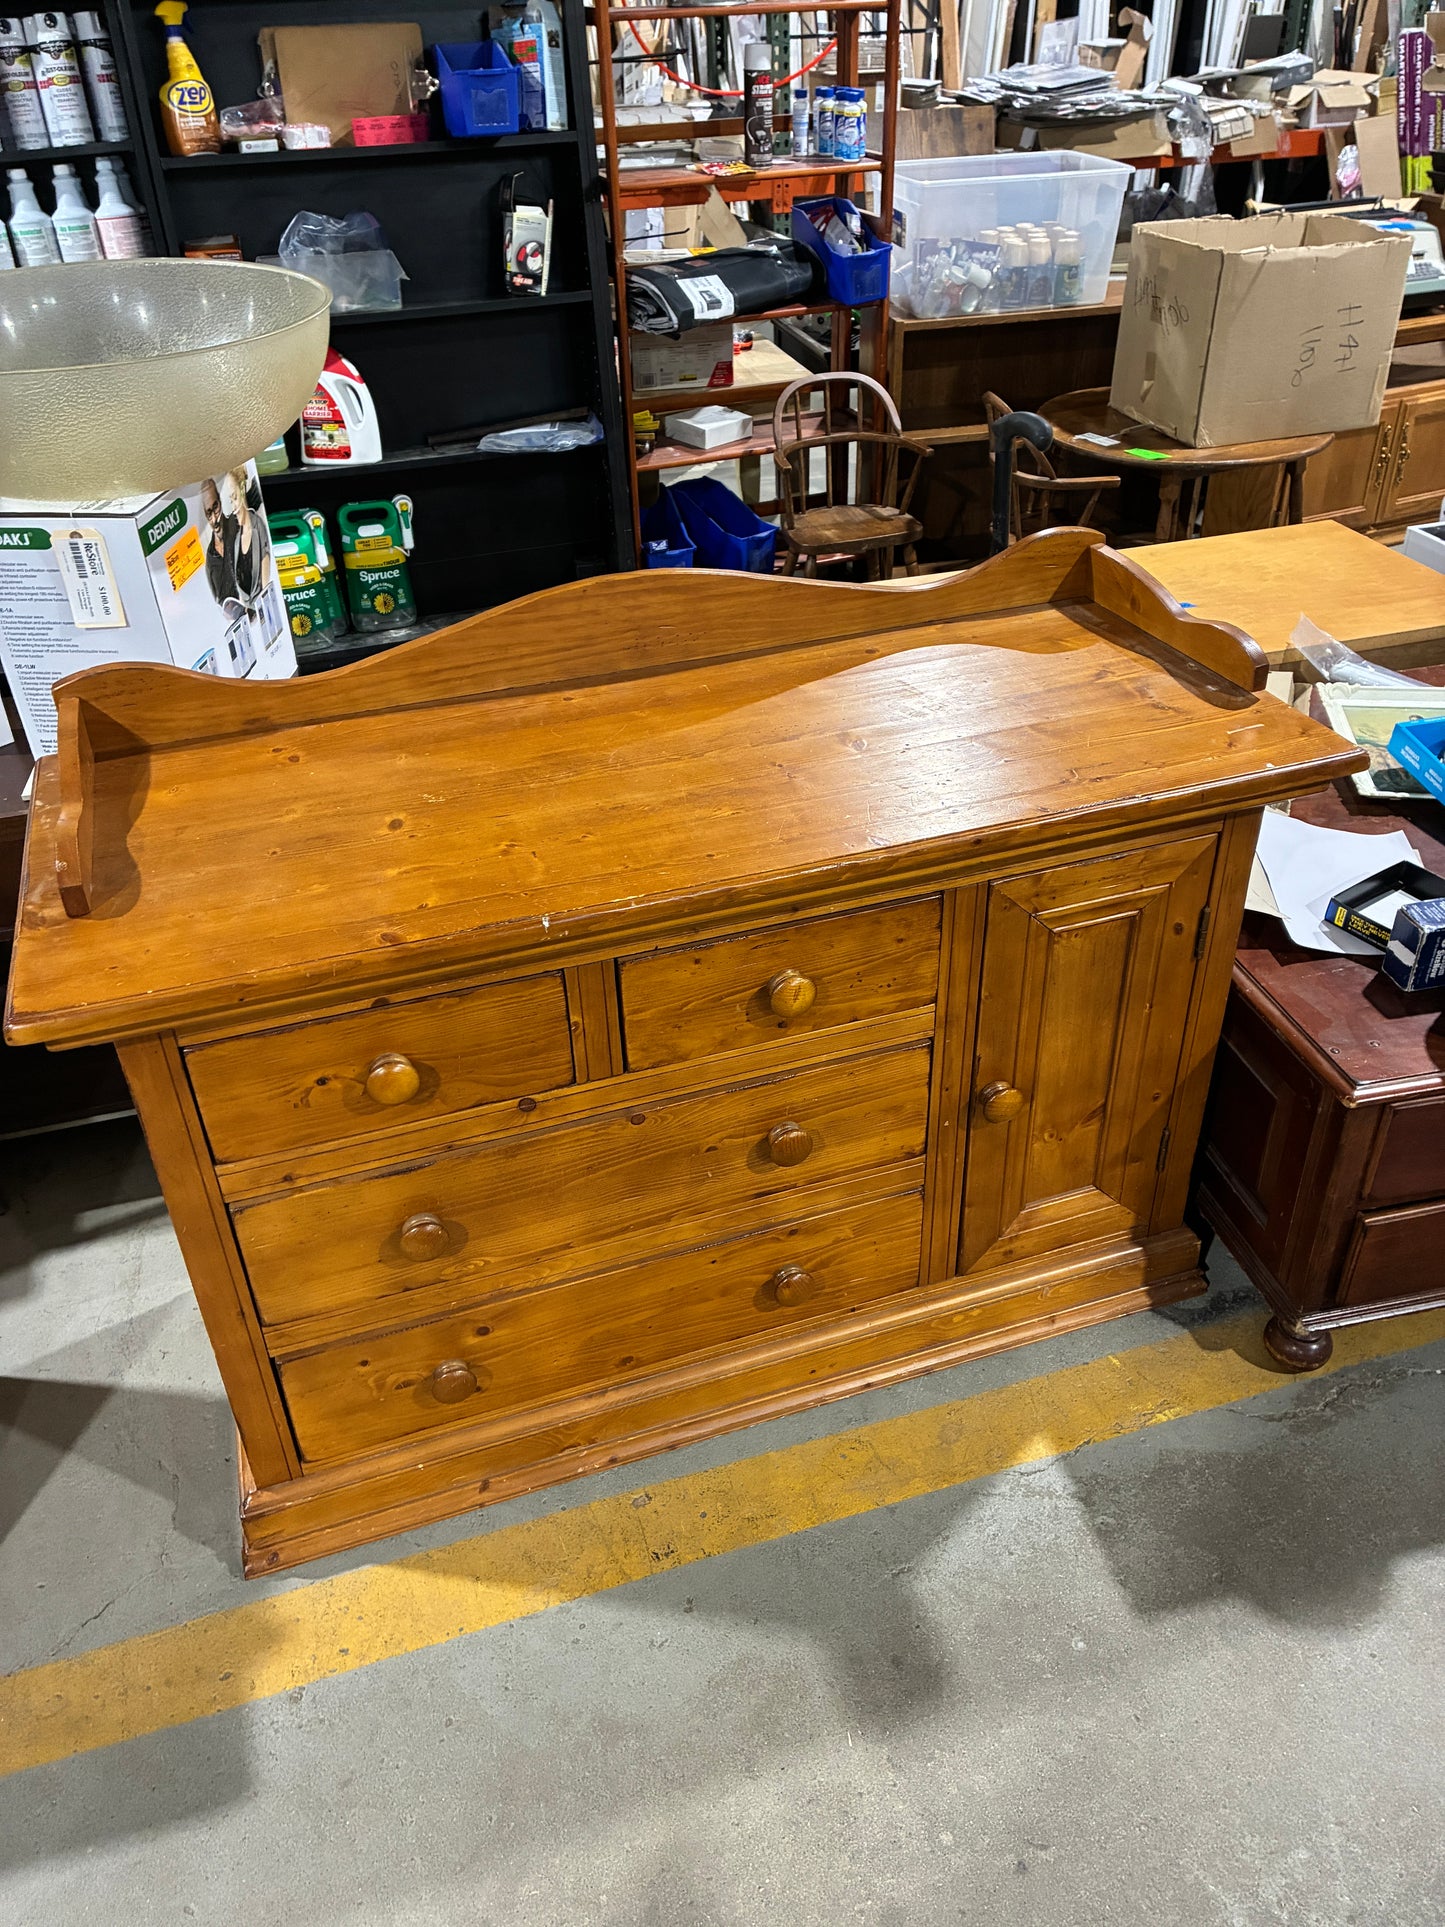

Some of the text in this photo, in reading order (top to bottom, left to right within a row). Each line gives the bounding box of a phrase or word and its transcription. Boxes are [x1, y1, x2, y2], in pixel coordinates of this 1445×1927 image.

[148, 508, 180, 545] DEDAKJ
[83, 542, 99, 576] ReStore
[359, 569, 400, 584] Spruce
[98, 586, 112, 616] $100.00
[283, 588, 316, 602] pruce
